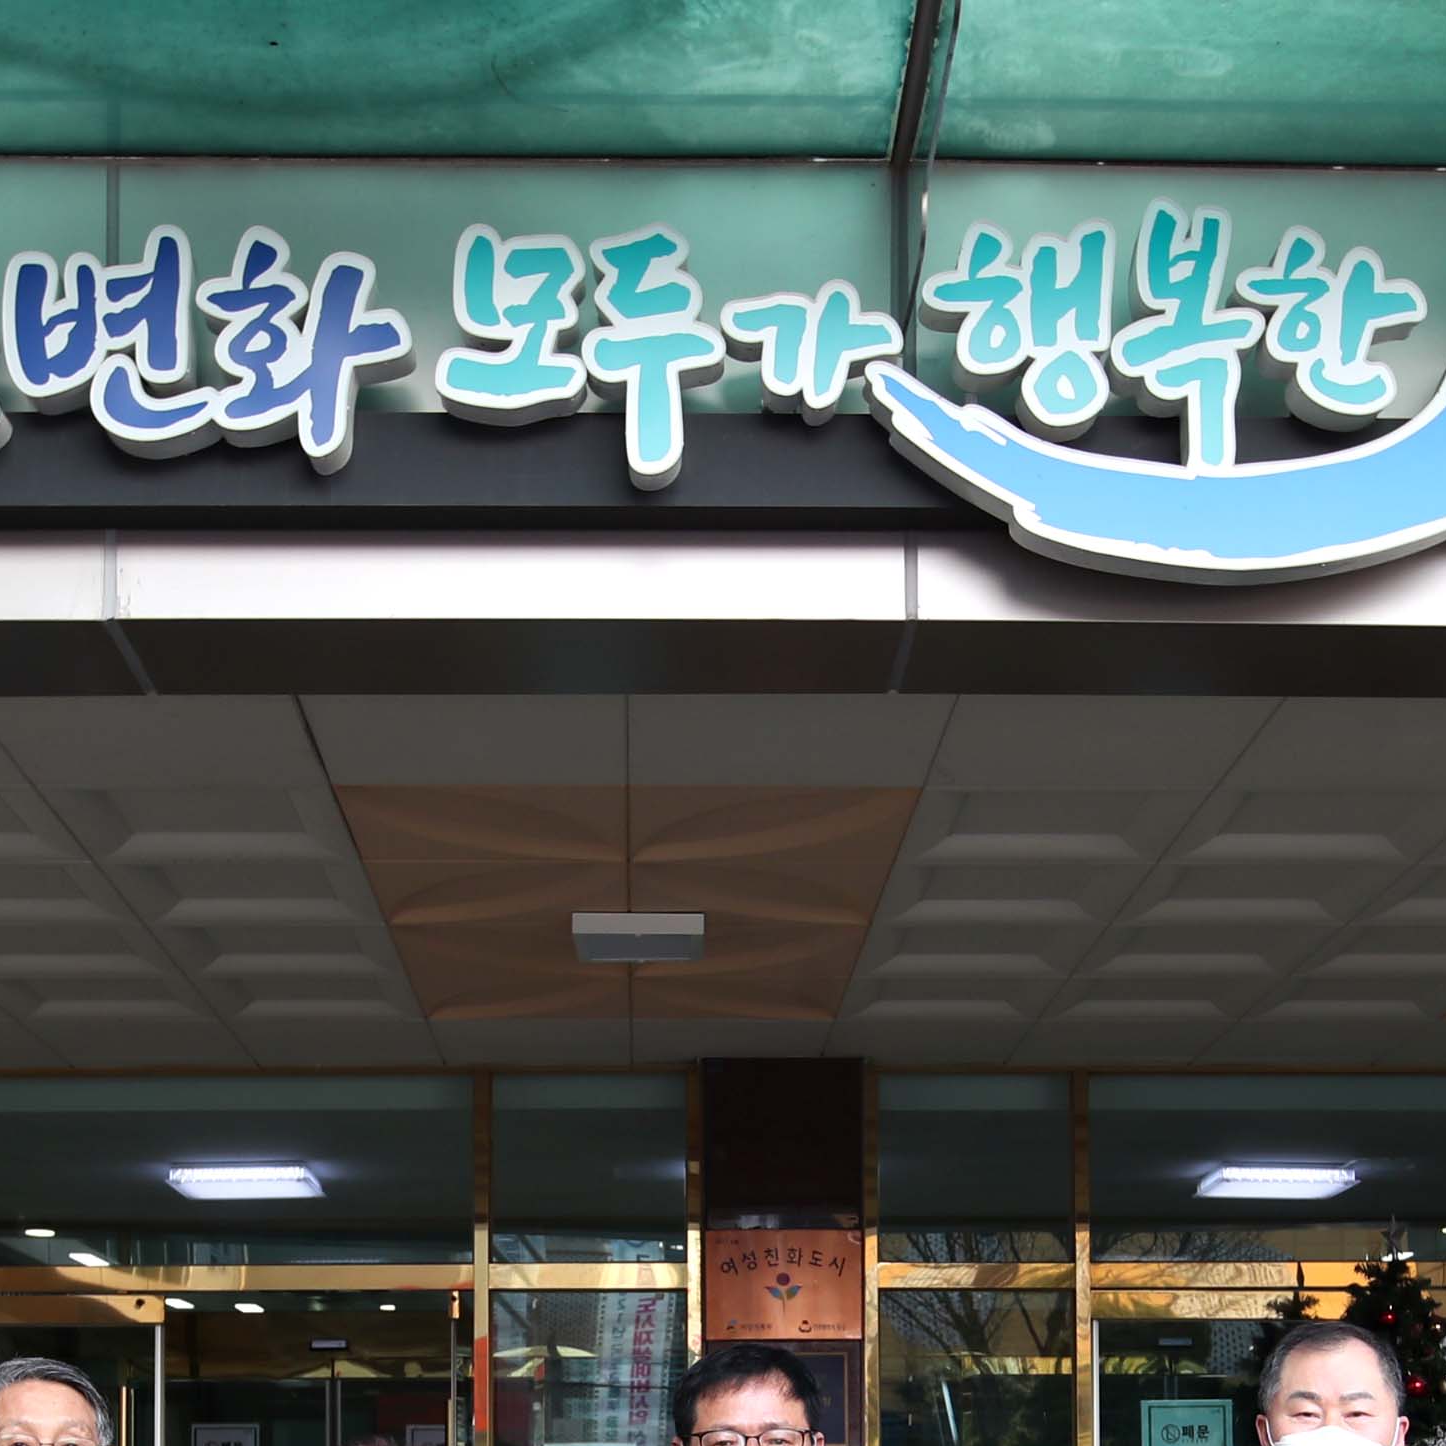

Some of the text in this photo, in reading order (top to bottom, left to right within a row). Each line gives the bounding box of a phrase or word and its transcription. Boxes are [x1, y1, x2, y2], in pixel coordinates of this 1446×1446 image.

[441, 226, 895, 470] 모두가
[925, 202, 1423, 468] 행복한
[720, 1246, 847, 1277] 여성친화도시
